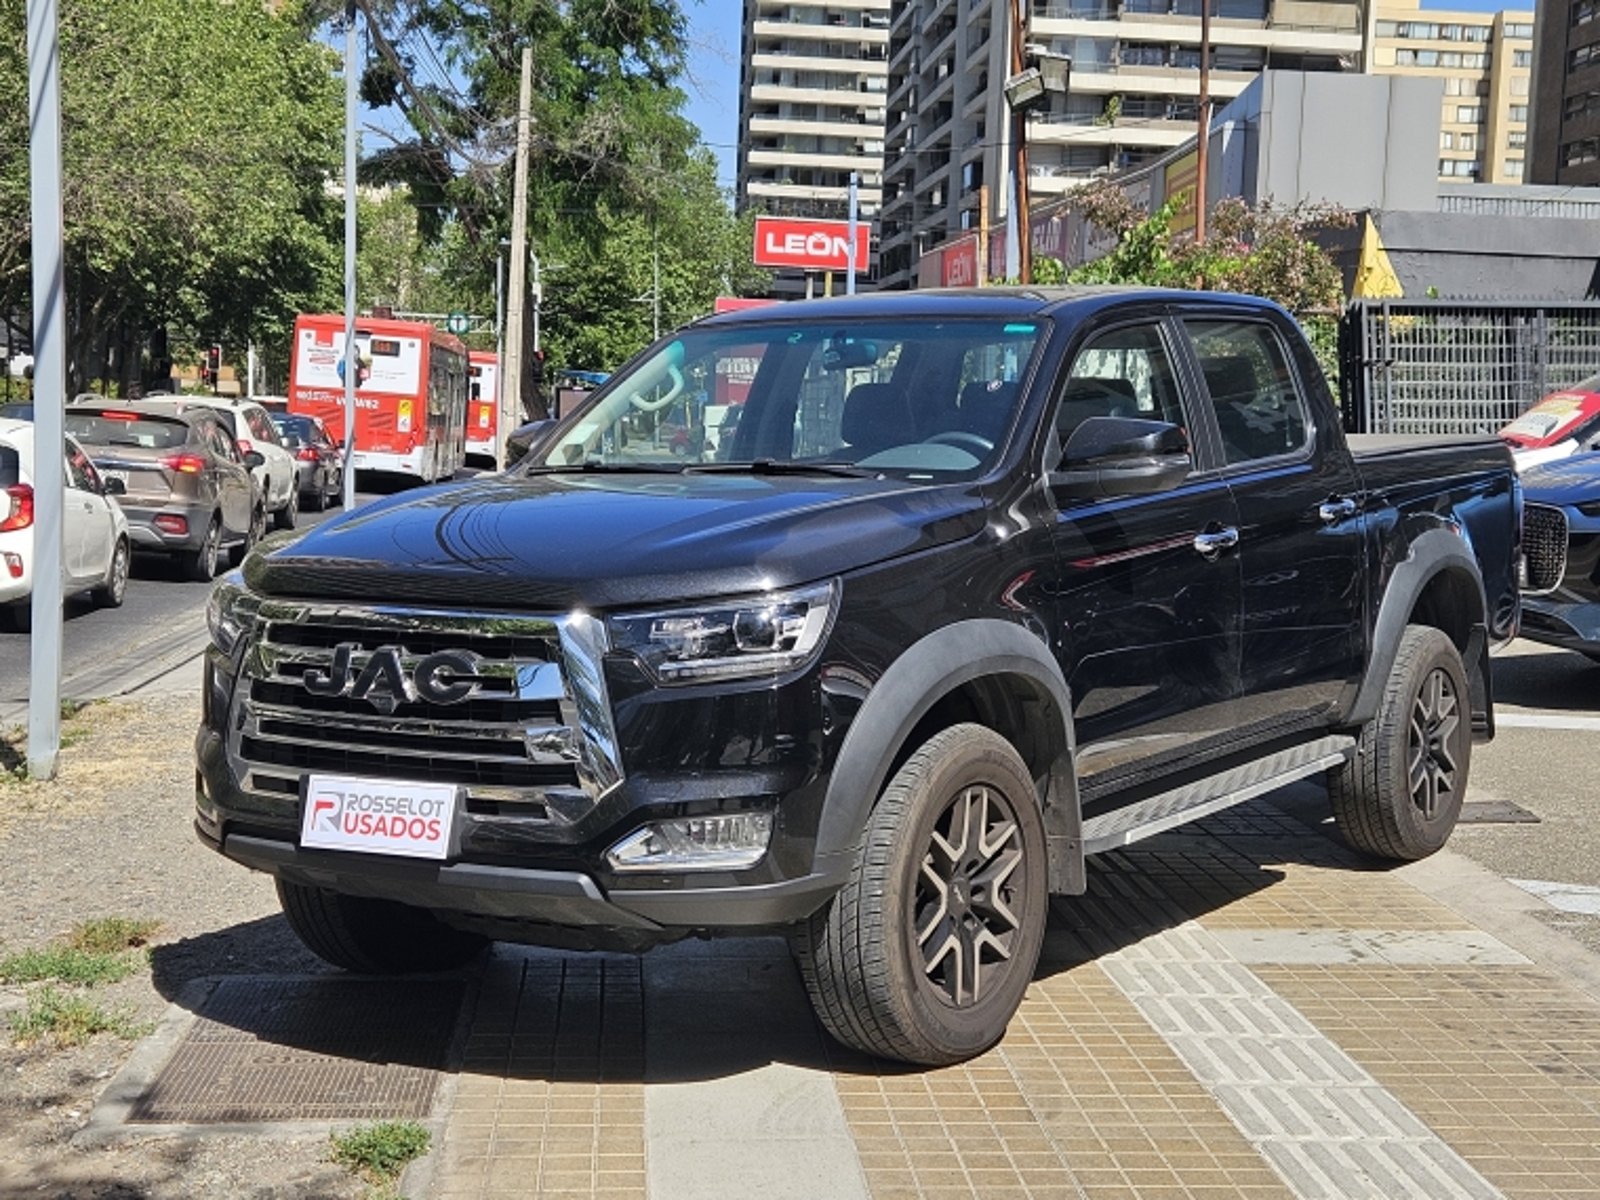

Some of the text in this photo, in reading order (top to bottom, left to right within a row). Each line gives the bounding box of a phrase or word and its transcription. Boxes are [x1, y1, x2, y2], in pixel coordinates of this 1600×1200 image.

[303, 642, 480, 705] JAC
[346, 793, 445, 817] ROSSELOT
[344, 814, 441, 841] USADOS
